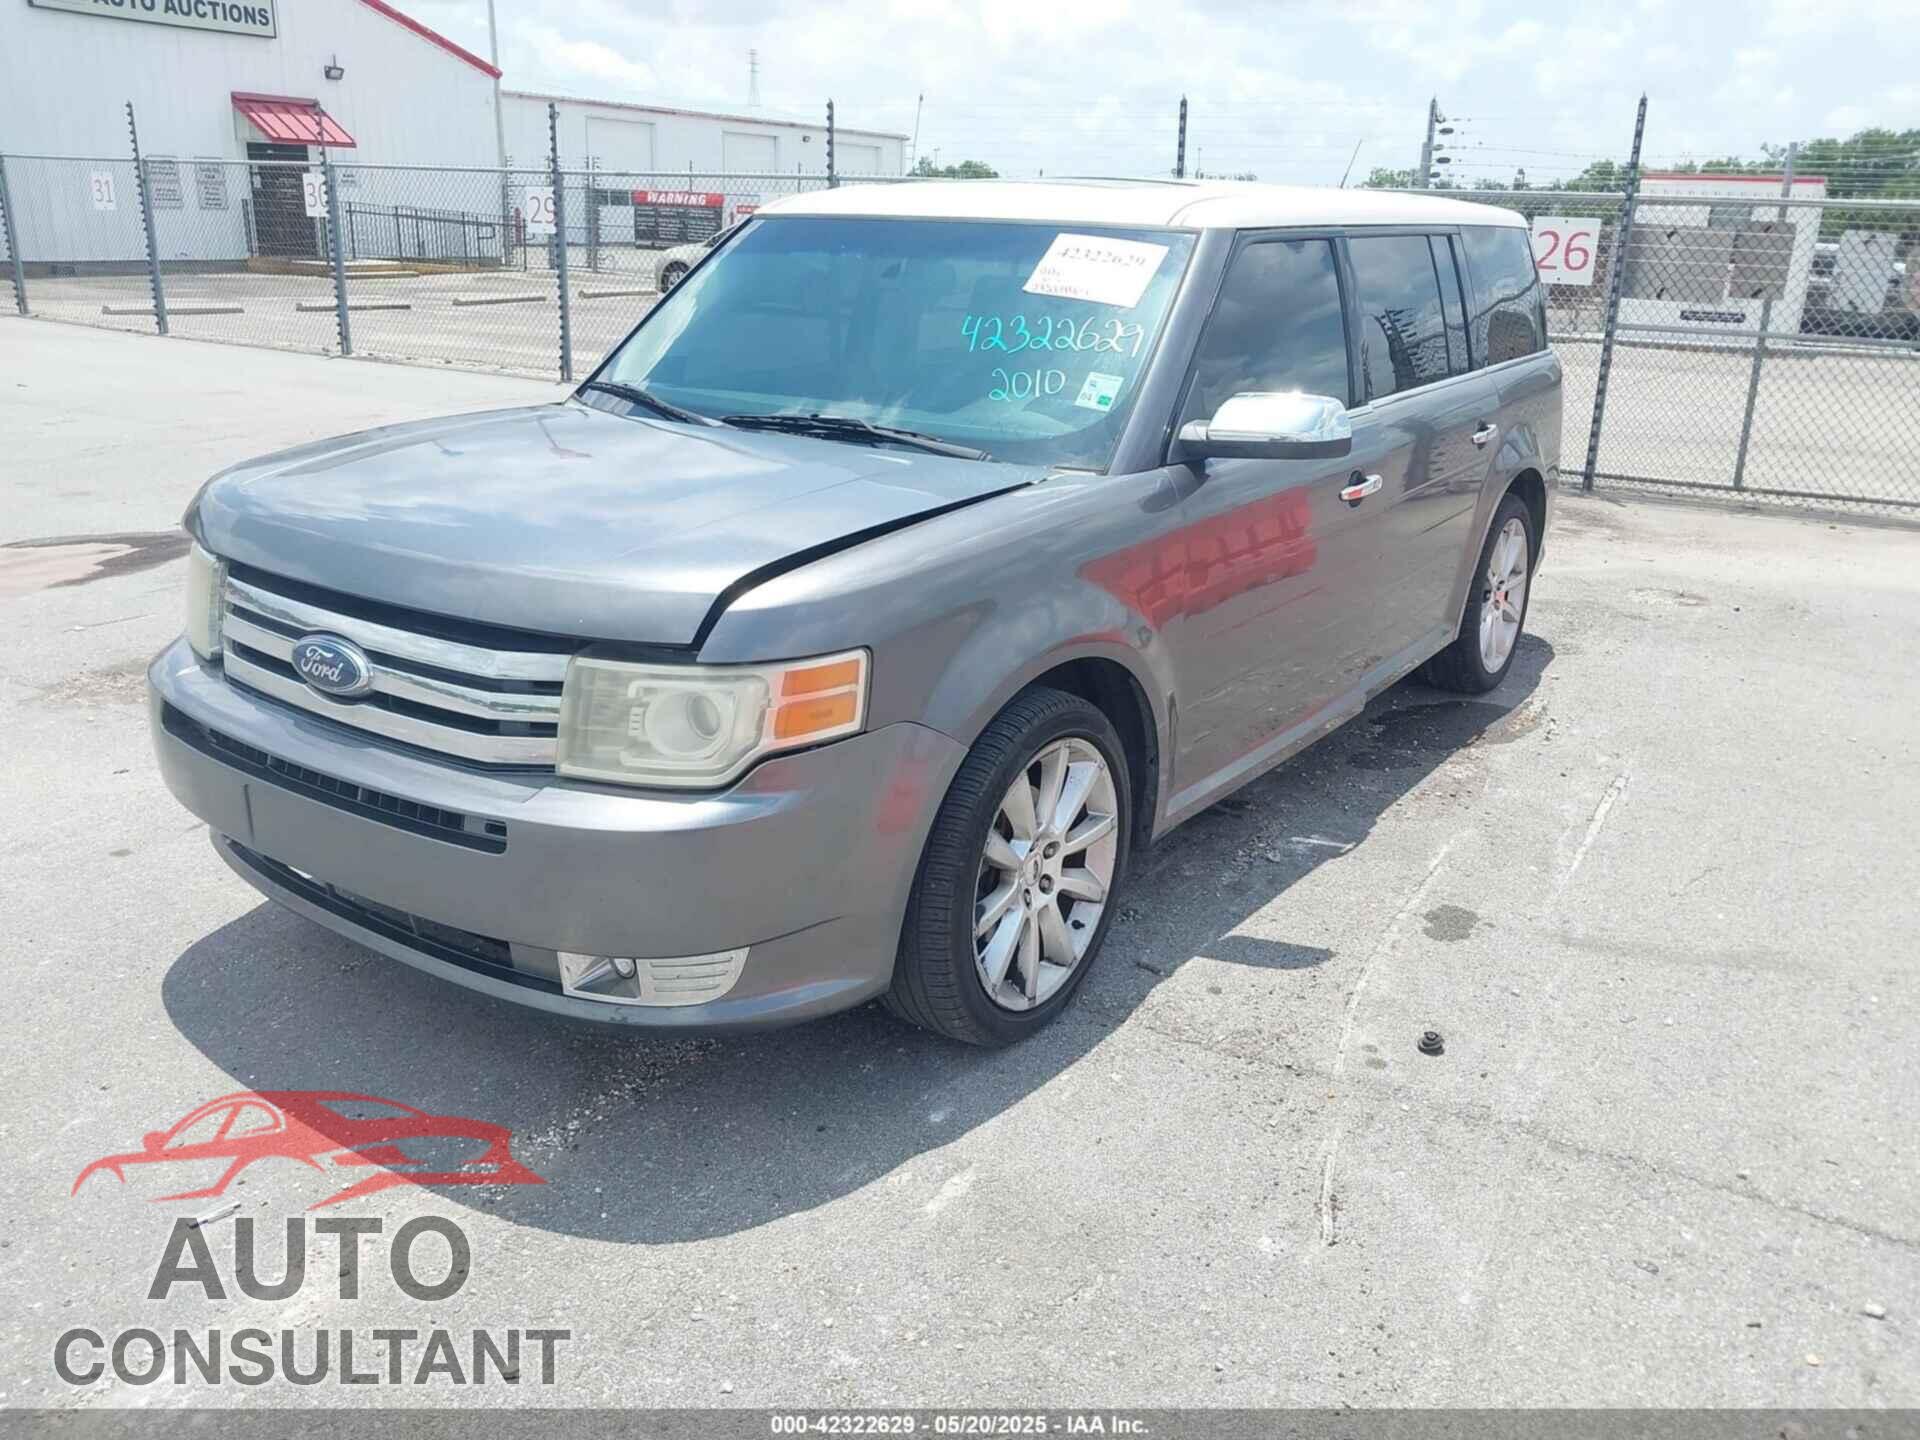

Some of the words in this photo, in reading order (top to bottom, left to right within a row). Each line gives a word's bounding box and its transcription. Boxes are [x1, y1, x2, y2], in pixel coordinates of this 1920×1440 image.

[164, 0, 270, 26] AUCTIONS
[94, 179, 113, 203] 31
[647, 191, 707, 206] WARNING
[529, 195, 556, 224] 29
[1536, 230, 1591, 271] 26
[961, 315, 1145, 357] 42322629
[988, 368, 1066, 402] 2010
[301, 646, 344, 682] Ford
